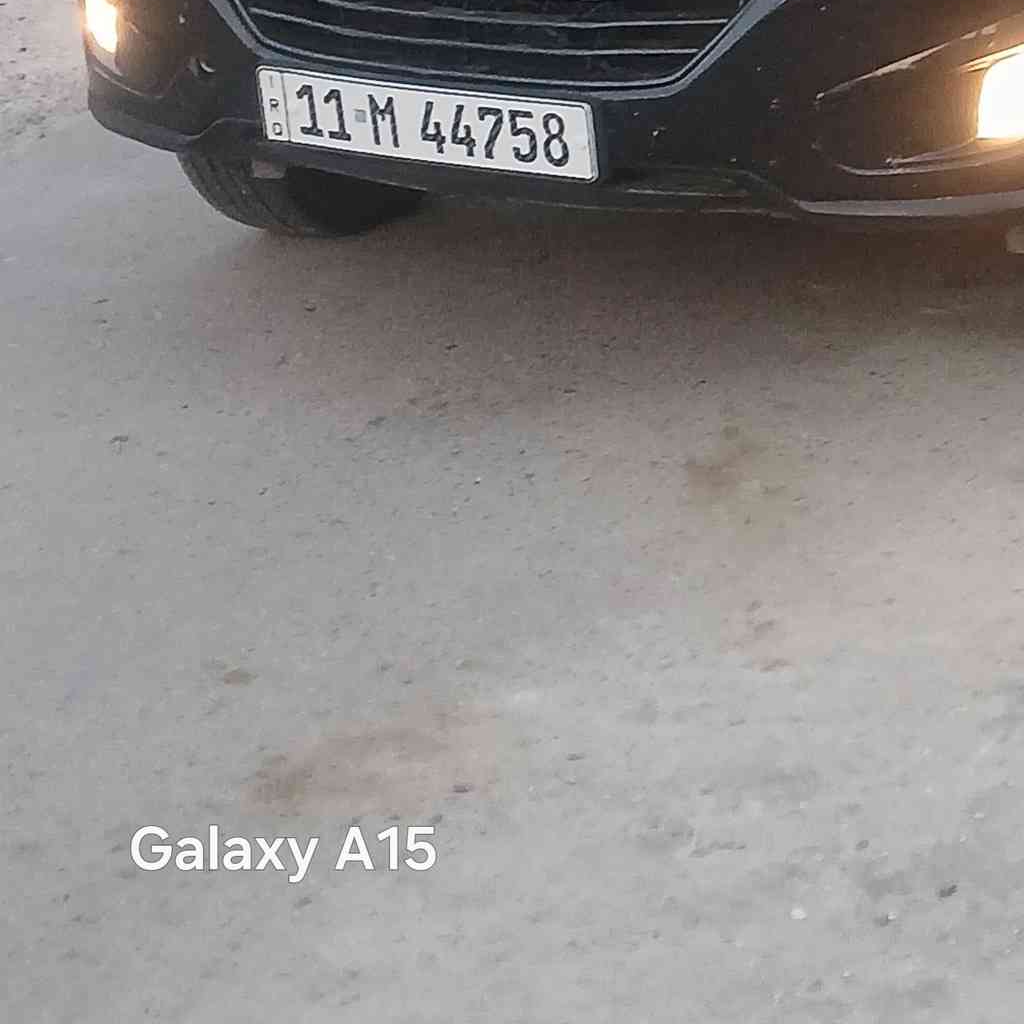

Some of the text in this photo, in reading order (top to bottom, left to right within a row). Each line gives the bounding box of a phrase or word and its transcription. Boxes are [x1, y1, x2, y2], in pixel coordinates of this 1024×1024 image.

[296, 84, 570, 167] 11 M 44758
